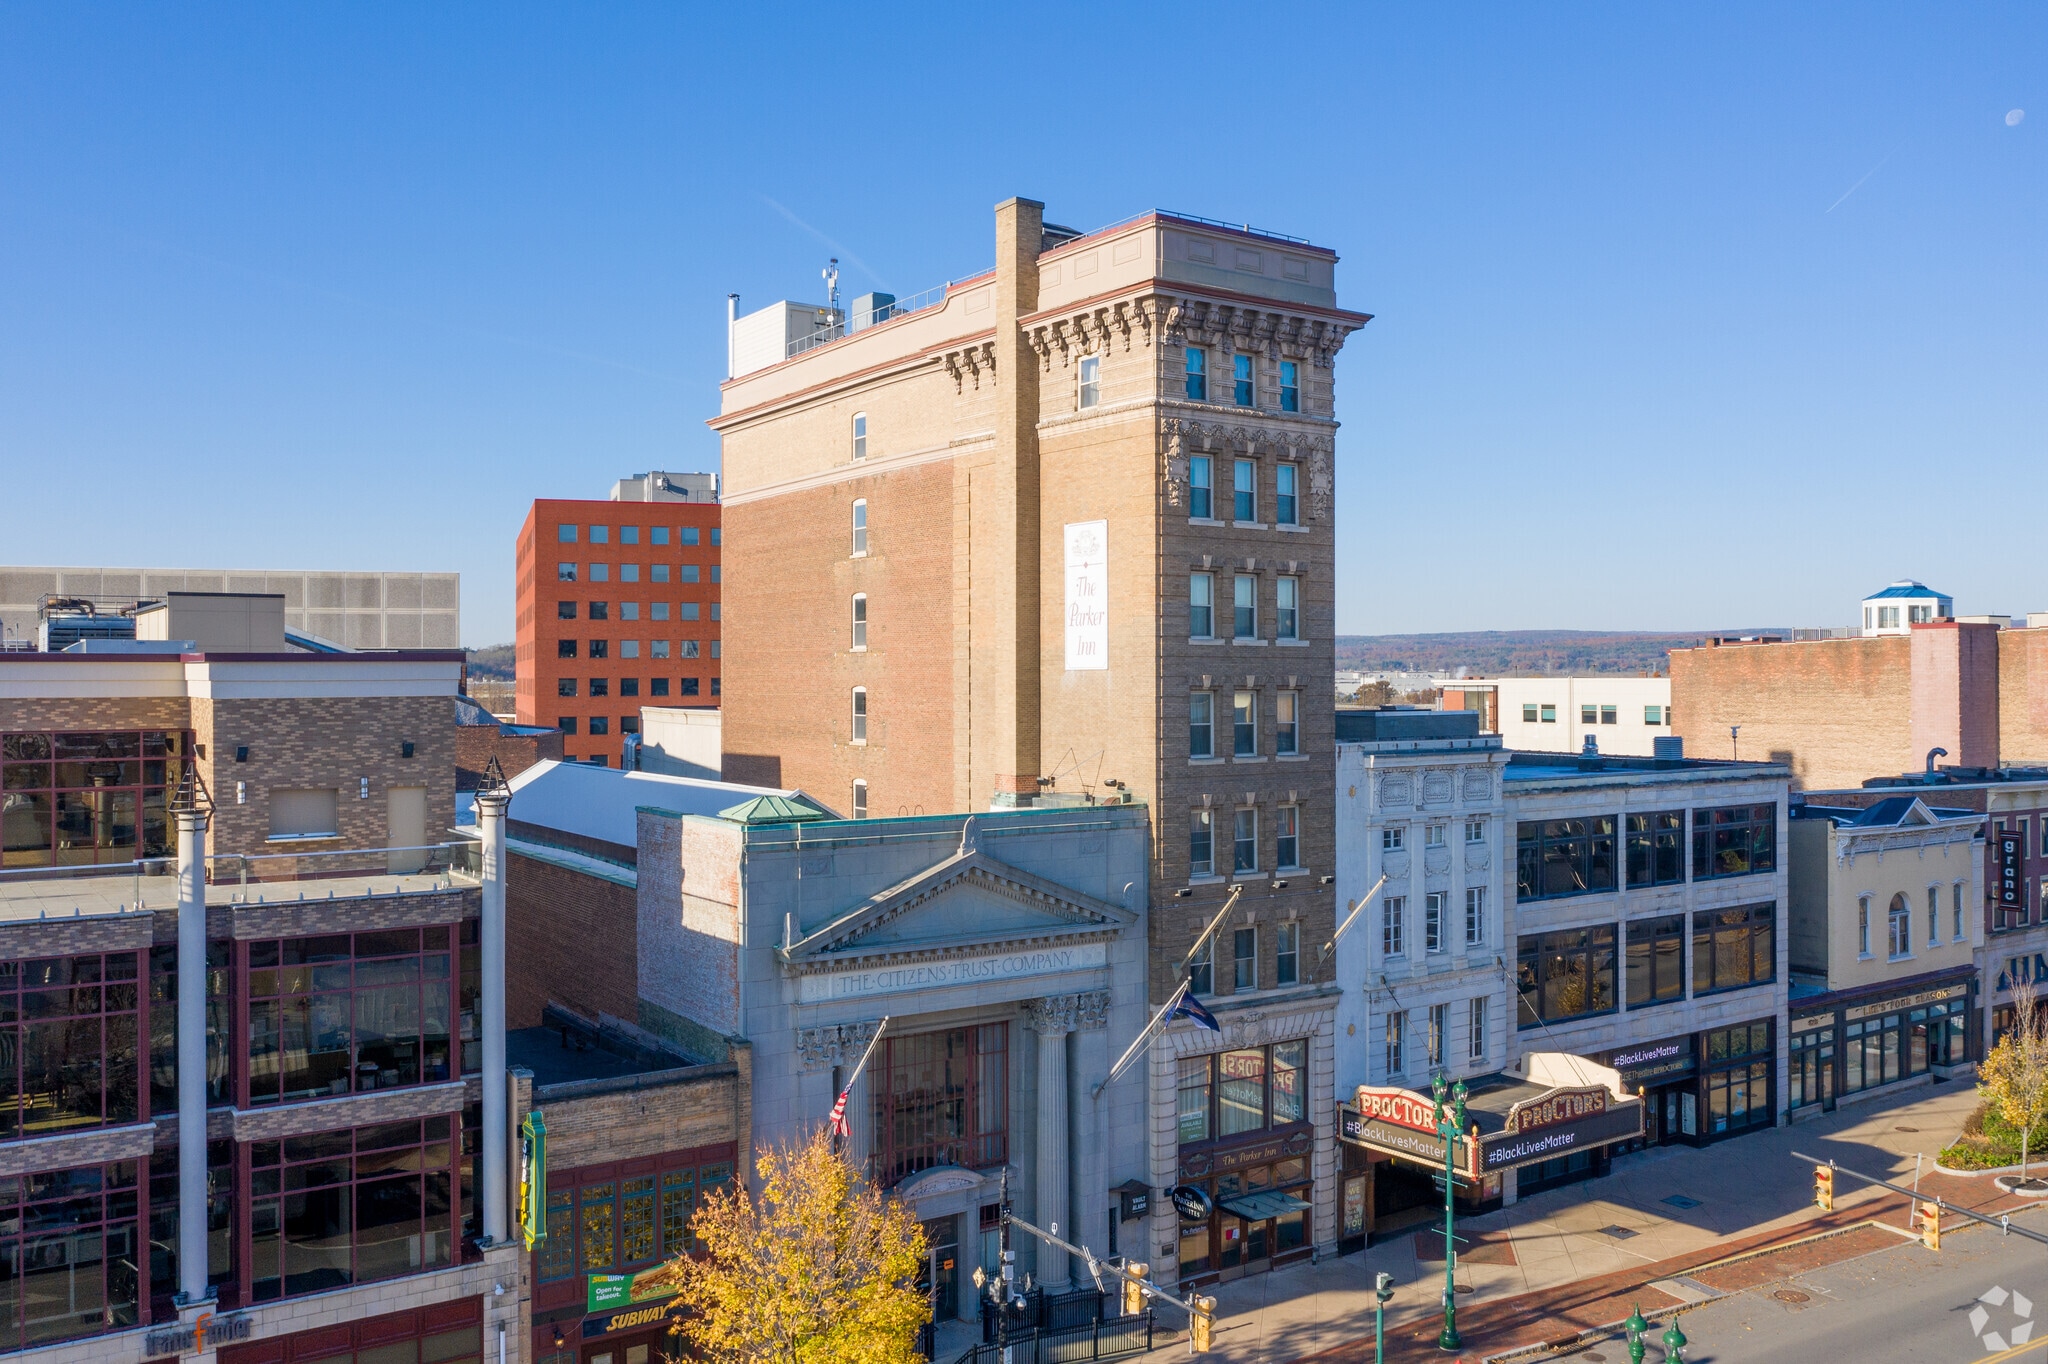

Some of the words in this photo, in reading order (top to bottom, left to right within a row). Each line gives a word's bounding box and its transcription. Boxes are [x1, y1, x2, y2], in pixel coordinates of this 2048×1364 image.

[1076, 576, 1096, 597] The
[1068, 602, 1105, 627] Parker
[1076, 635, 1096, 655] Inn
[2004, 840, 2015, 901] grano
[839, 975, 873, 993] THE
[877, 966, 947, 987] CITIZENS
[948, 959, 999, 980] TRUST
[1001, 951, 1074, 973] COMPANY
[1613, 1045, 1680, 1067] #BlackLivesMatter
[1360, 1094, 1445, 1131] PROCTOR
[1346, 1120, 1446, 1159] #BlackLivesMatter
[1488, 1133, 1575, 1164] #BlackLivesMatter
[1222, 1155, 1236, 1166] The
[1239, 1150, 1261, 1163] Parker
[1264, 1147, 1277, 1157] Inn
[592, 1274, 625, 1284] SUBWAY
[595, 1287, 612, 1295] Open
[605, 1305, 670, 1332] SUBWAY
[145, 1312, 254, 1357] transfinder
